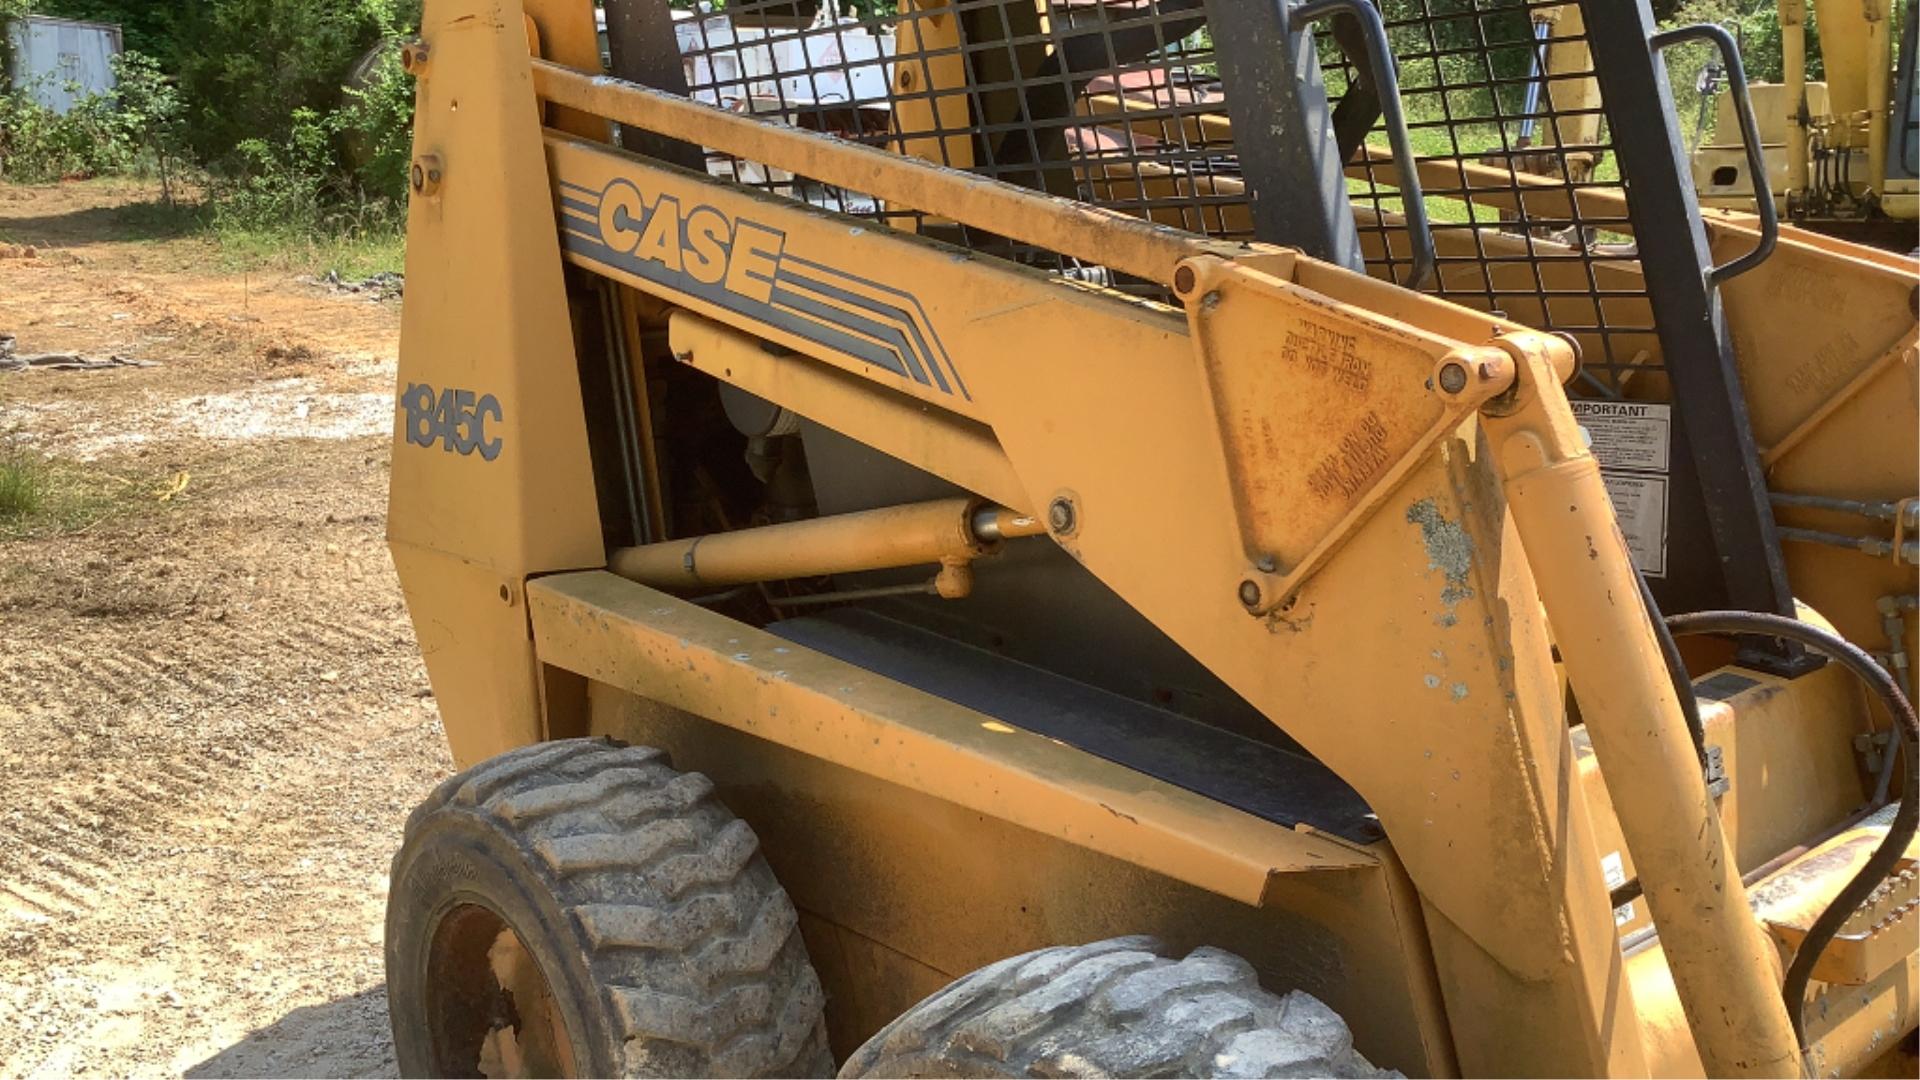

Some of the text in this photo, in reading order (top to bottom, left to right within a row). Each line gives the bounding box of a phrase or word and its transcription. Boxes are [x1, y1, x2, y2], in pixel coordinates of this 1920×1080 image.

[598, 178, 786, 305] CASE
[400, 382, 502, 462] 1845C
[1570, 403, 1648, 417] MPORTANT
